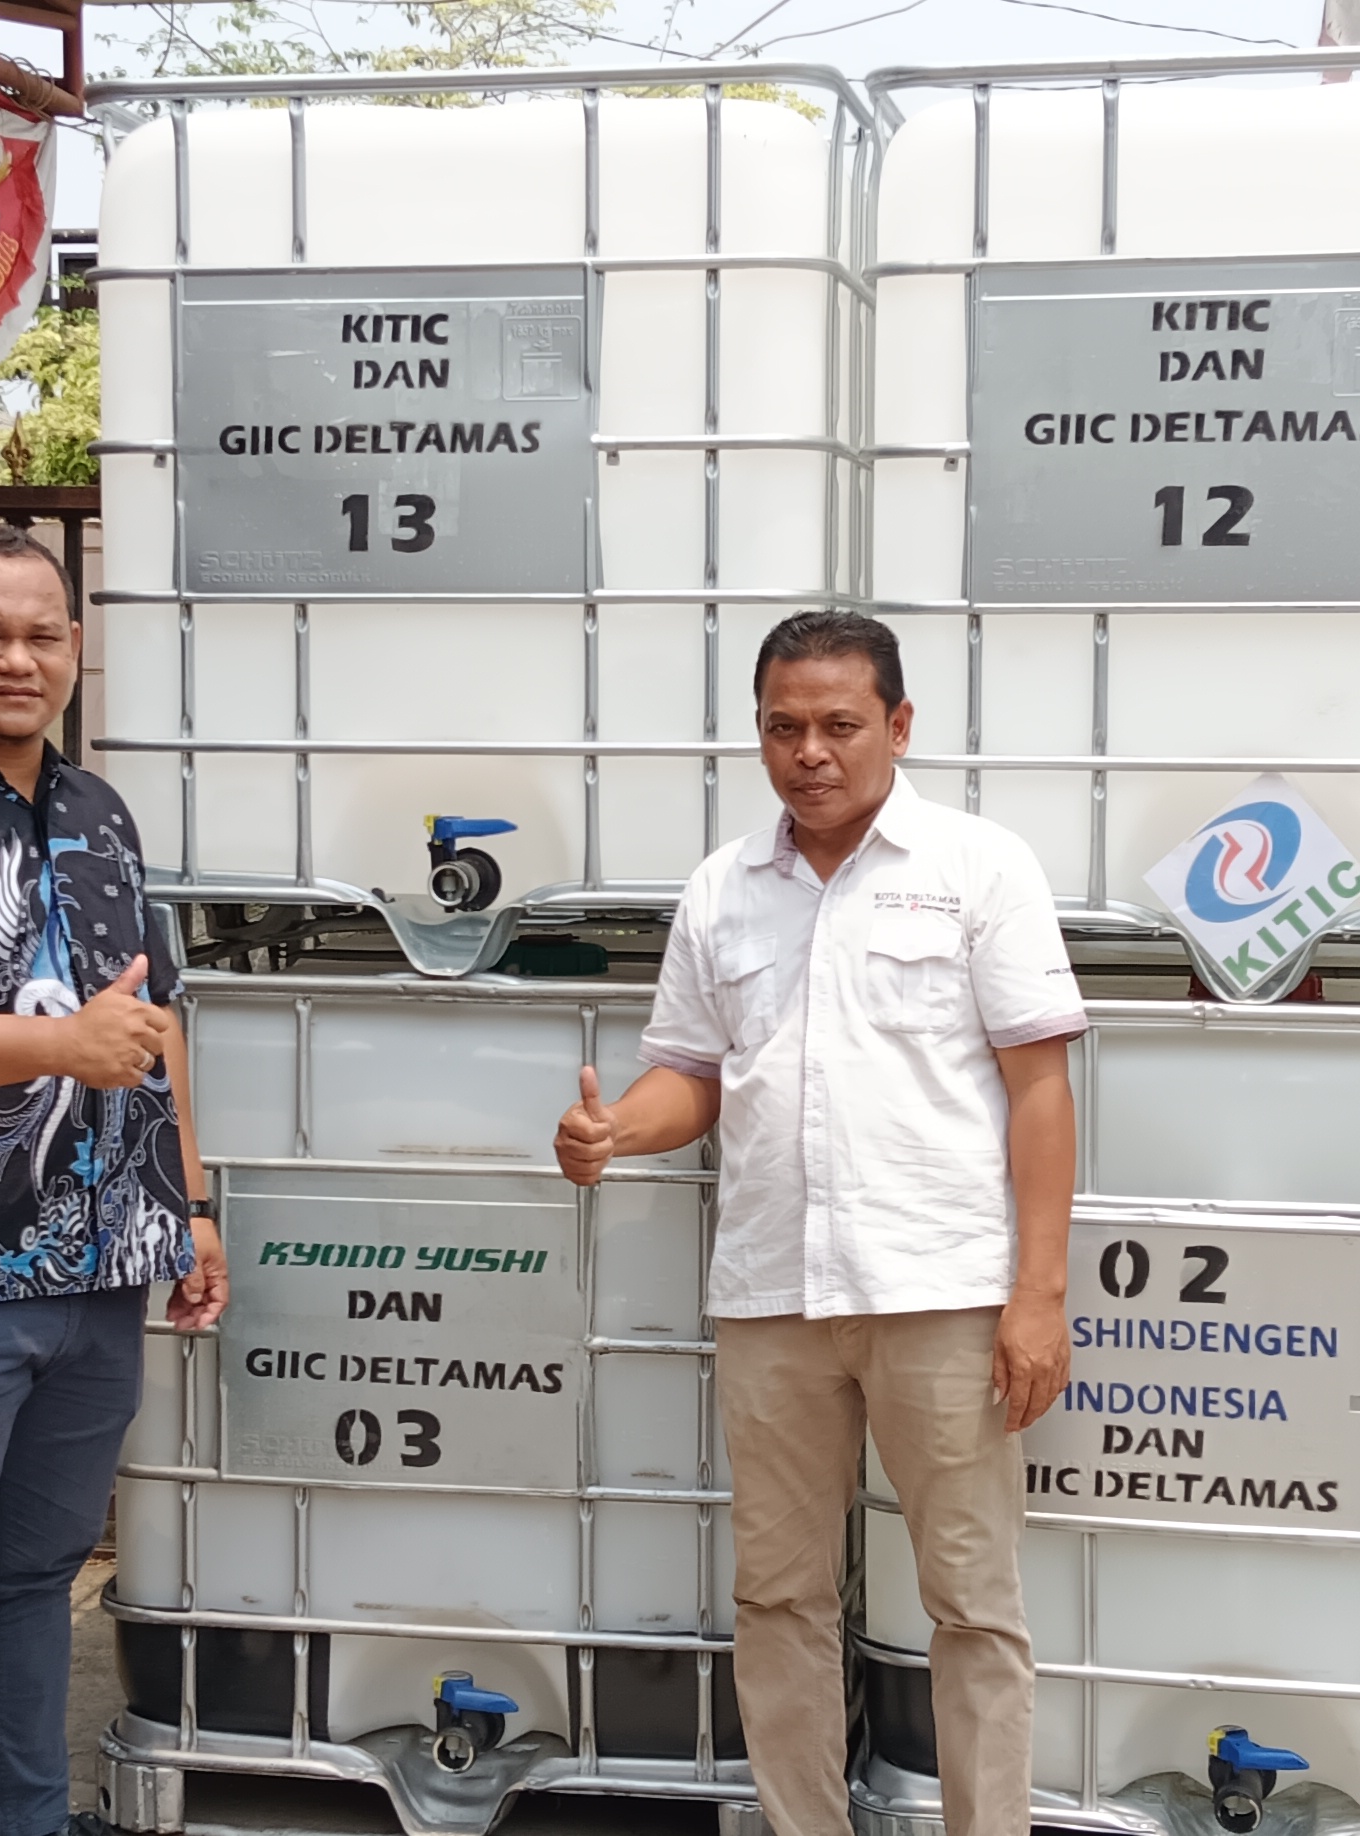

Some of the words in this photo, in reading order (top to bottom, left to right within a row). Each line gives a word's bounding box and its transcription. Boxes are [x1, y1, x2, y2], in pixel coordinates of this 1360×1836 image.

[341, 313, 449, 345] KITIC
[1152, 299, 1271, 332] KITIC
[353, 359, 450, 390] DAN
[1159, 349, 1264, 382] DAN
[219, 425, 301, 455] GIIC
[314, 422, 541, 454] DELTAMAS
[1025, 413, 1116, 445] GIIC
[341, 494, 436, 553] 13
[1154, 485, 1255, 547] 12
[258, 1241, 406, 1269] KYODO
[415, 1247, 548, 1273] YUSHI
[1099, 1239, 1230, 1304] 02
[347, 1290, 443, 1322] DAN
[1072, 1316, 1338, 1358] SHINDENGEN
[245, 1347, 326, 1381] GIIC
[339, 1354, 564, 1394] DELTAMAS
[1063, 1381, 1288, 1421] INDONESIA
[335, 1408, 441, 1468] 03
[1101, 1424, 1204, 1459] DAN
[1025, 1463, 1081, 1496] IIC
[1094, 1470, 1339, 1513] DELTAMAS
